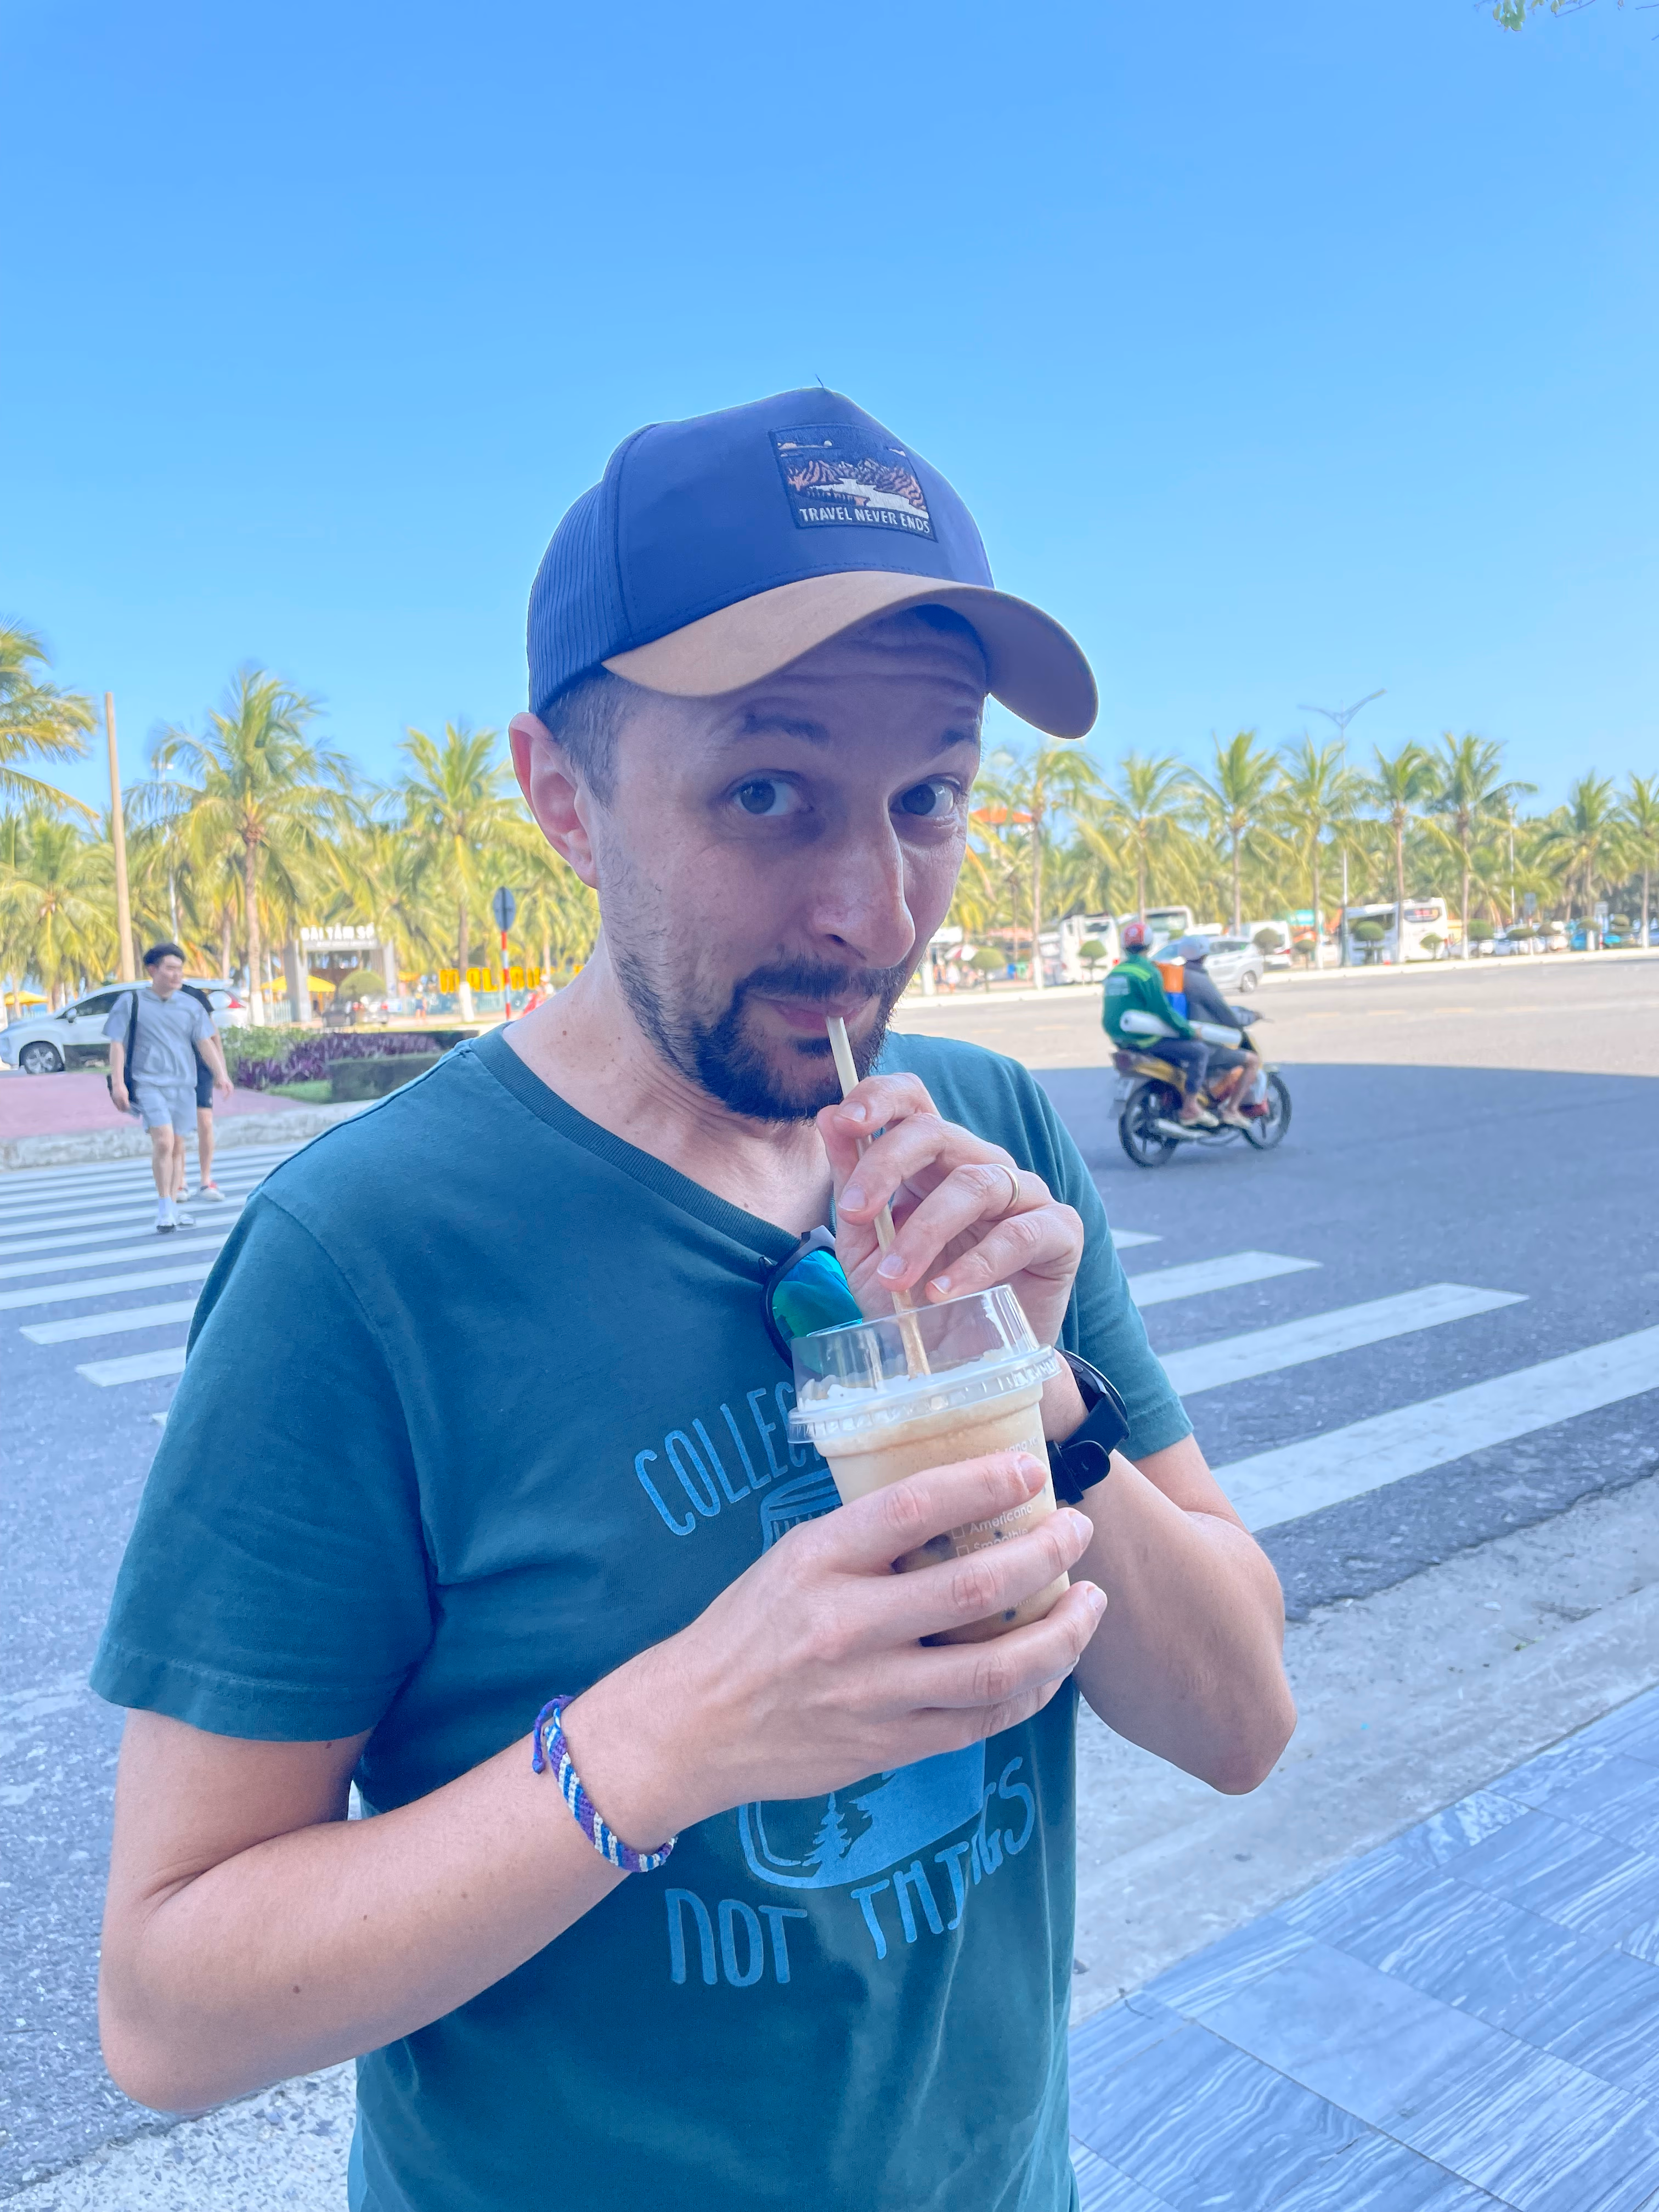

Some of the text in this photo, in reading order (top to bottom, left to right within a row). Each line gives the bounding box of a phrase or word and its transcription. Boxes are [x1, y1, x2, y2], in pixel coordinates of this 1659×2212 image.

[799, 506, 930, 534] TRAVEL NEVER ENDS
[635, 1381, 821, 1536] COLLEC
[969, 1504, 1032, 1534] Americano
